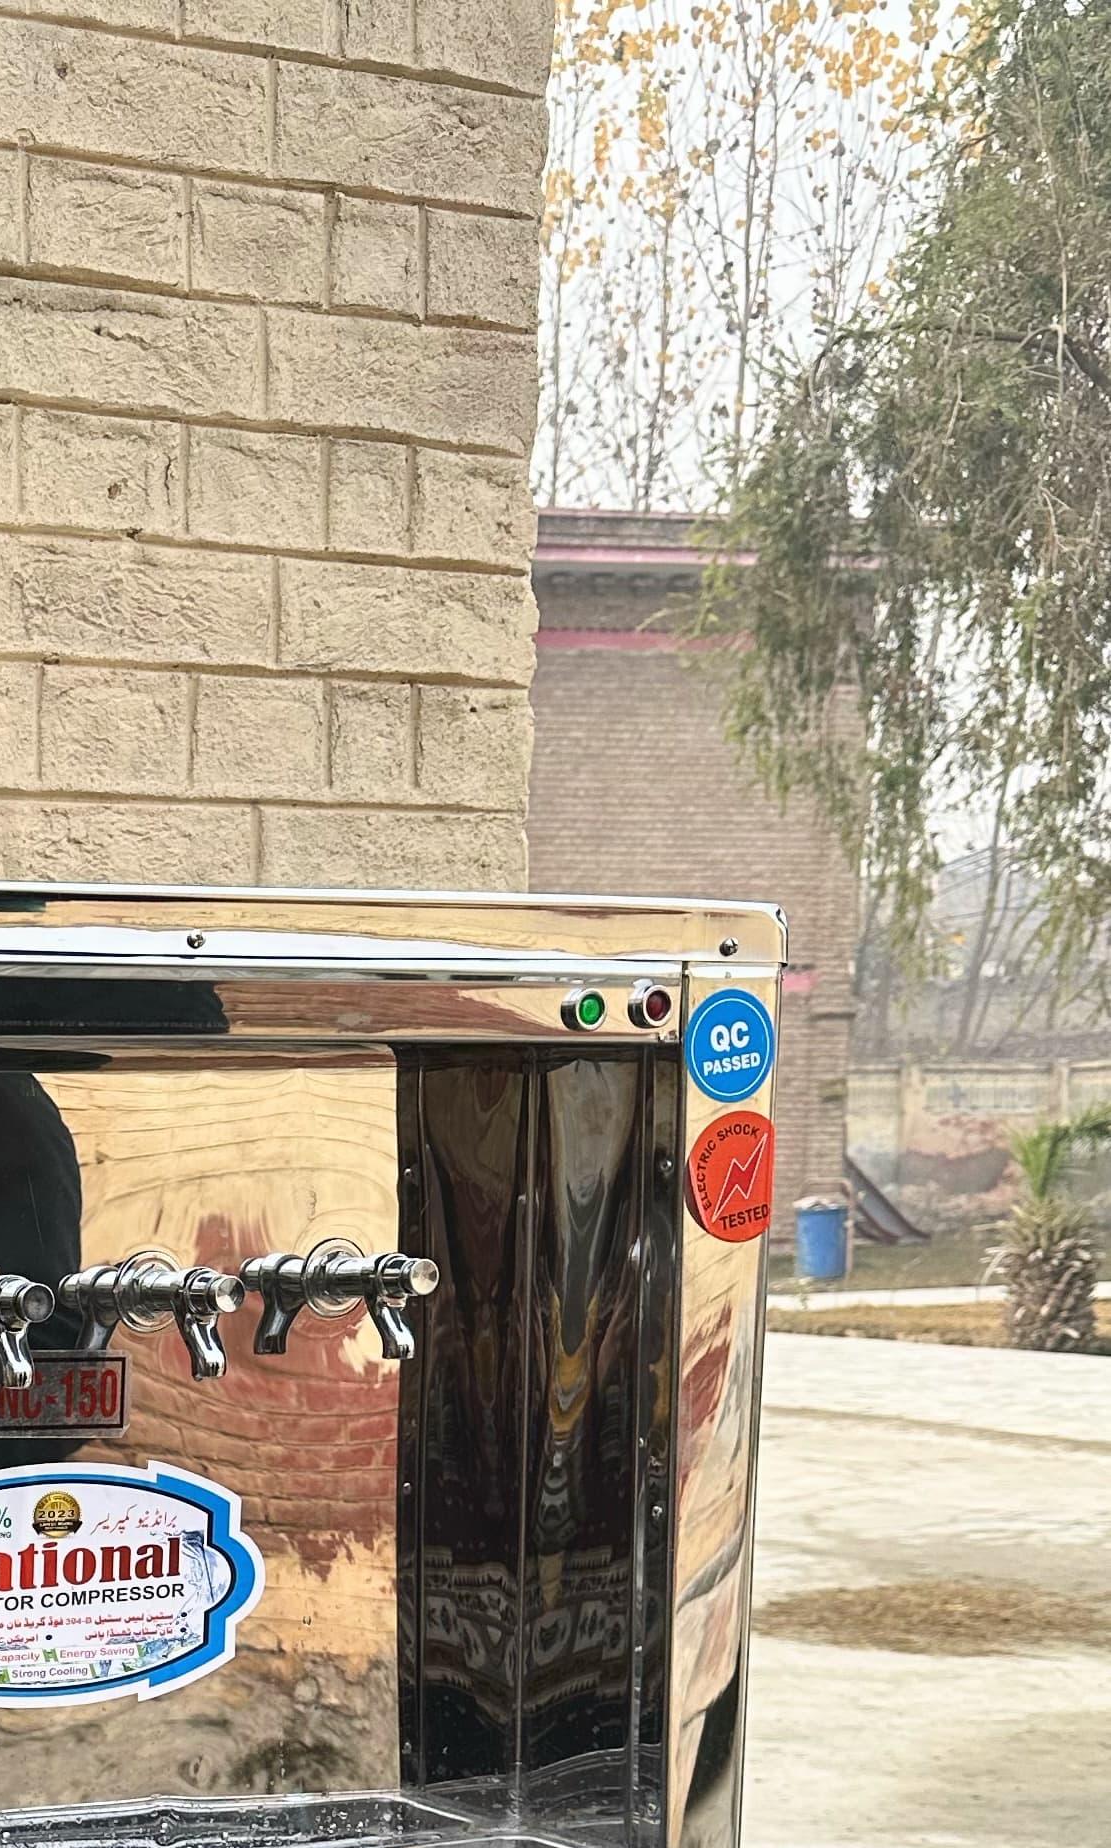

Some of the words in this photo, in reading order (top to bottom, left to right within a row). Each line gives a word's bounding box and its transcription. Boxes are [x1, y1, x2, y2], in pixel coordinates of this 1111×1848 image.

[709, 1020, 751, 1053] QC
[702, 1051, 761, 1077] PASSED
[695, 1140, 717, 1211] ELECTRIC
[716, 1123, 760, 1142] SHOCK
[719, 1203, 769, 1231] TESTED
[38, 1509, 75, 1519] 2023
[40, 1583, 185, 1608] COMPRESSOR
[59, 1648, 98, 1660] Energy
[100, 1645, 135, 1657] Saving
[11, 1668, 48, 1680] Strong
[49, 1665, 88, 1677] Cooling
